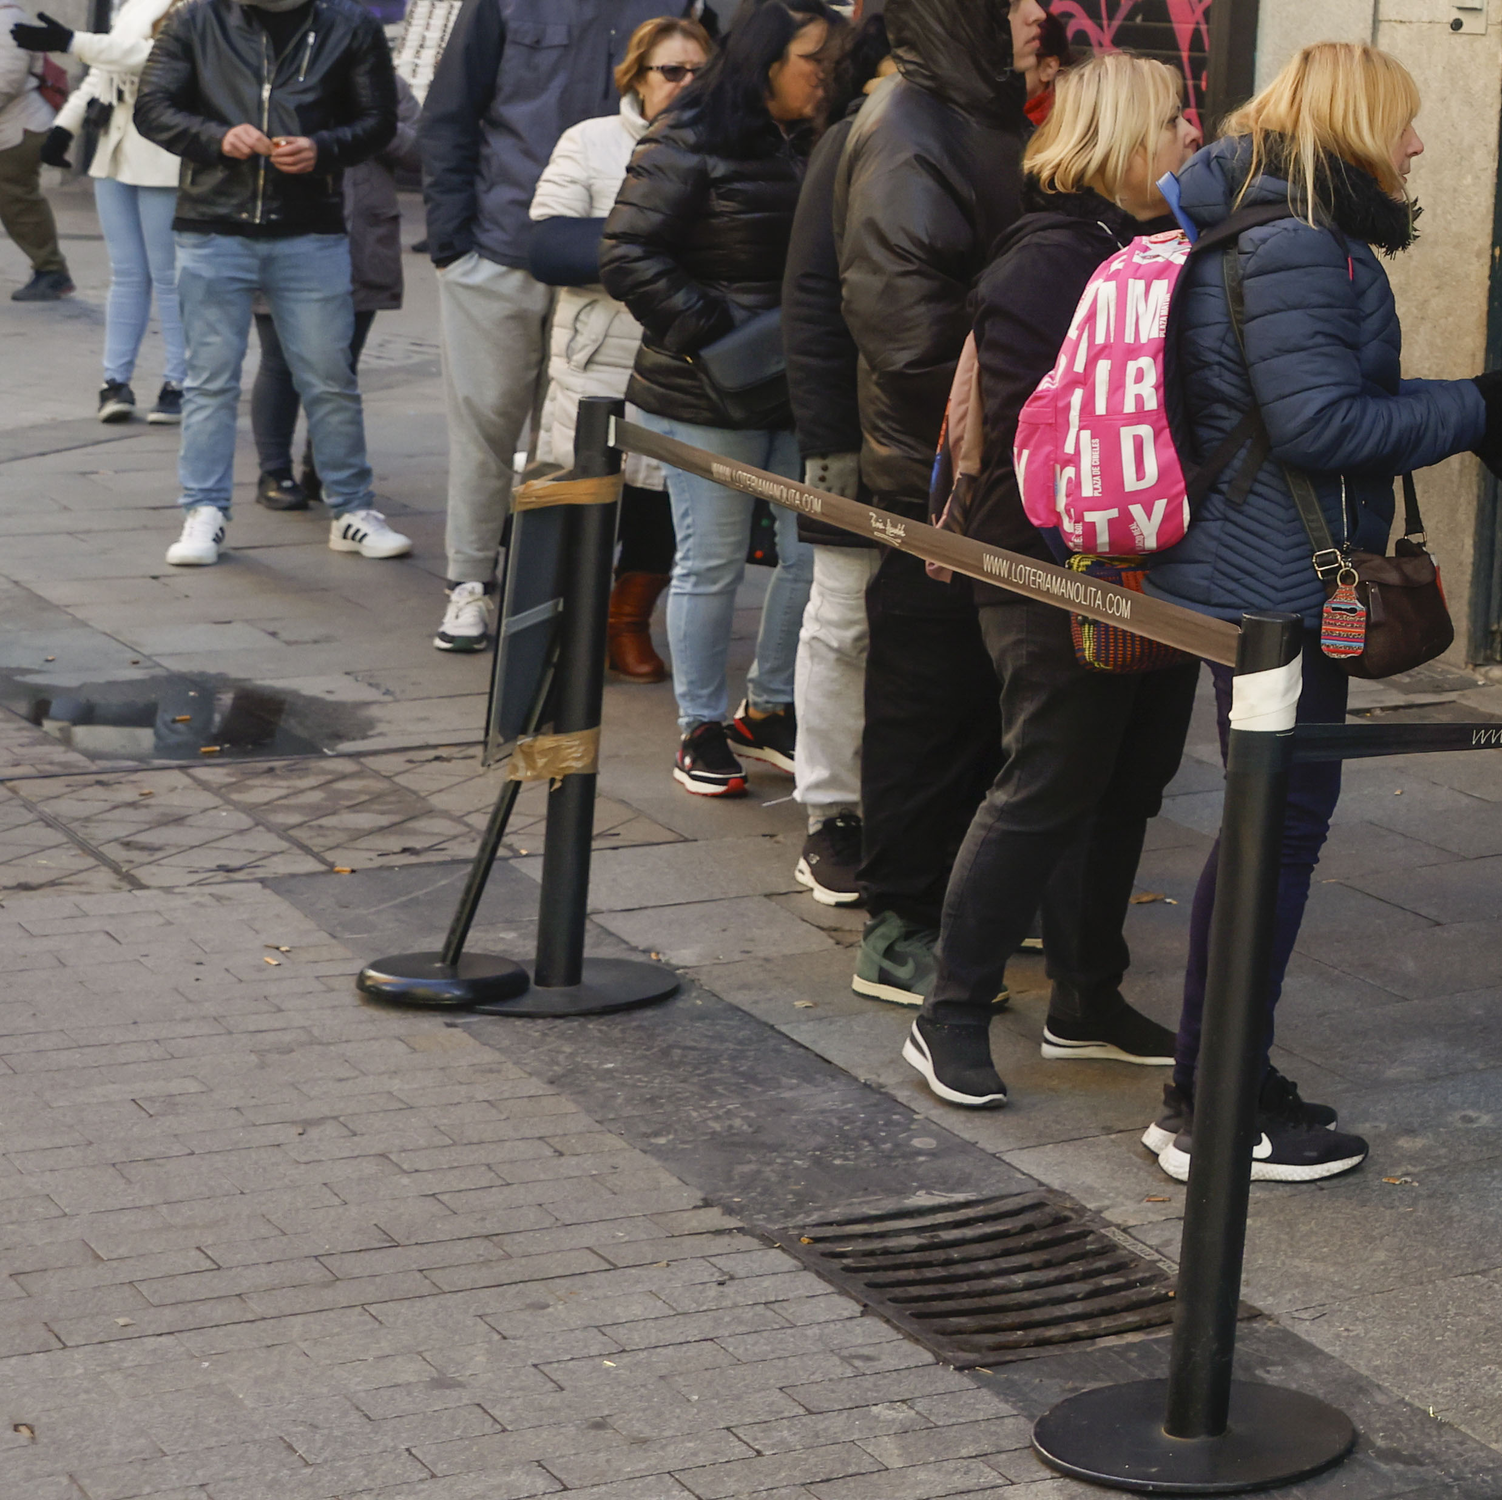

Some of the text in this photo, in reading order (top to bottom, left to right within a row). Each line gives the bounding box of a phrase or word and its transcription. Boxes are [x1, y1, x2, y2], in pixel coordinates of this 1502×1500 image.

[711, 461, 823, 514] WWW.LOTERIAMANOLITA.COM
[1092, 475, 1102, 496] PLAZA
[983, 552, 1132, 621] WWW.LOTERIAMANOLITA.COM
